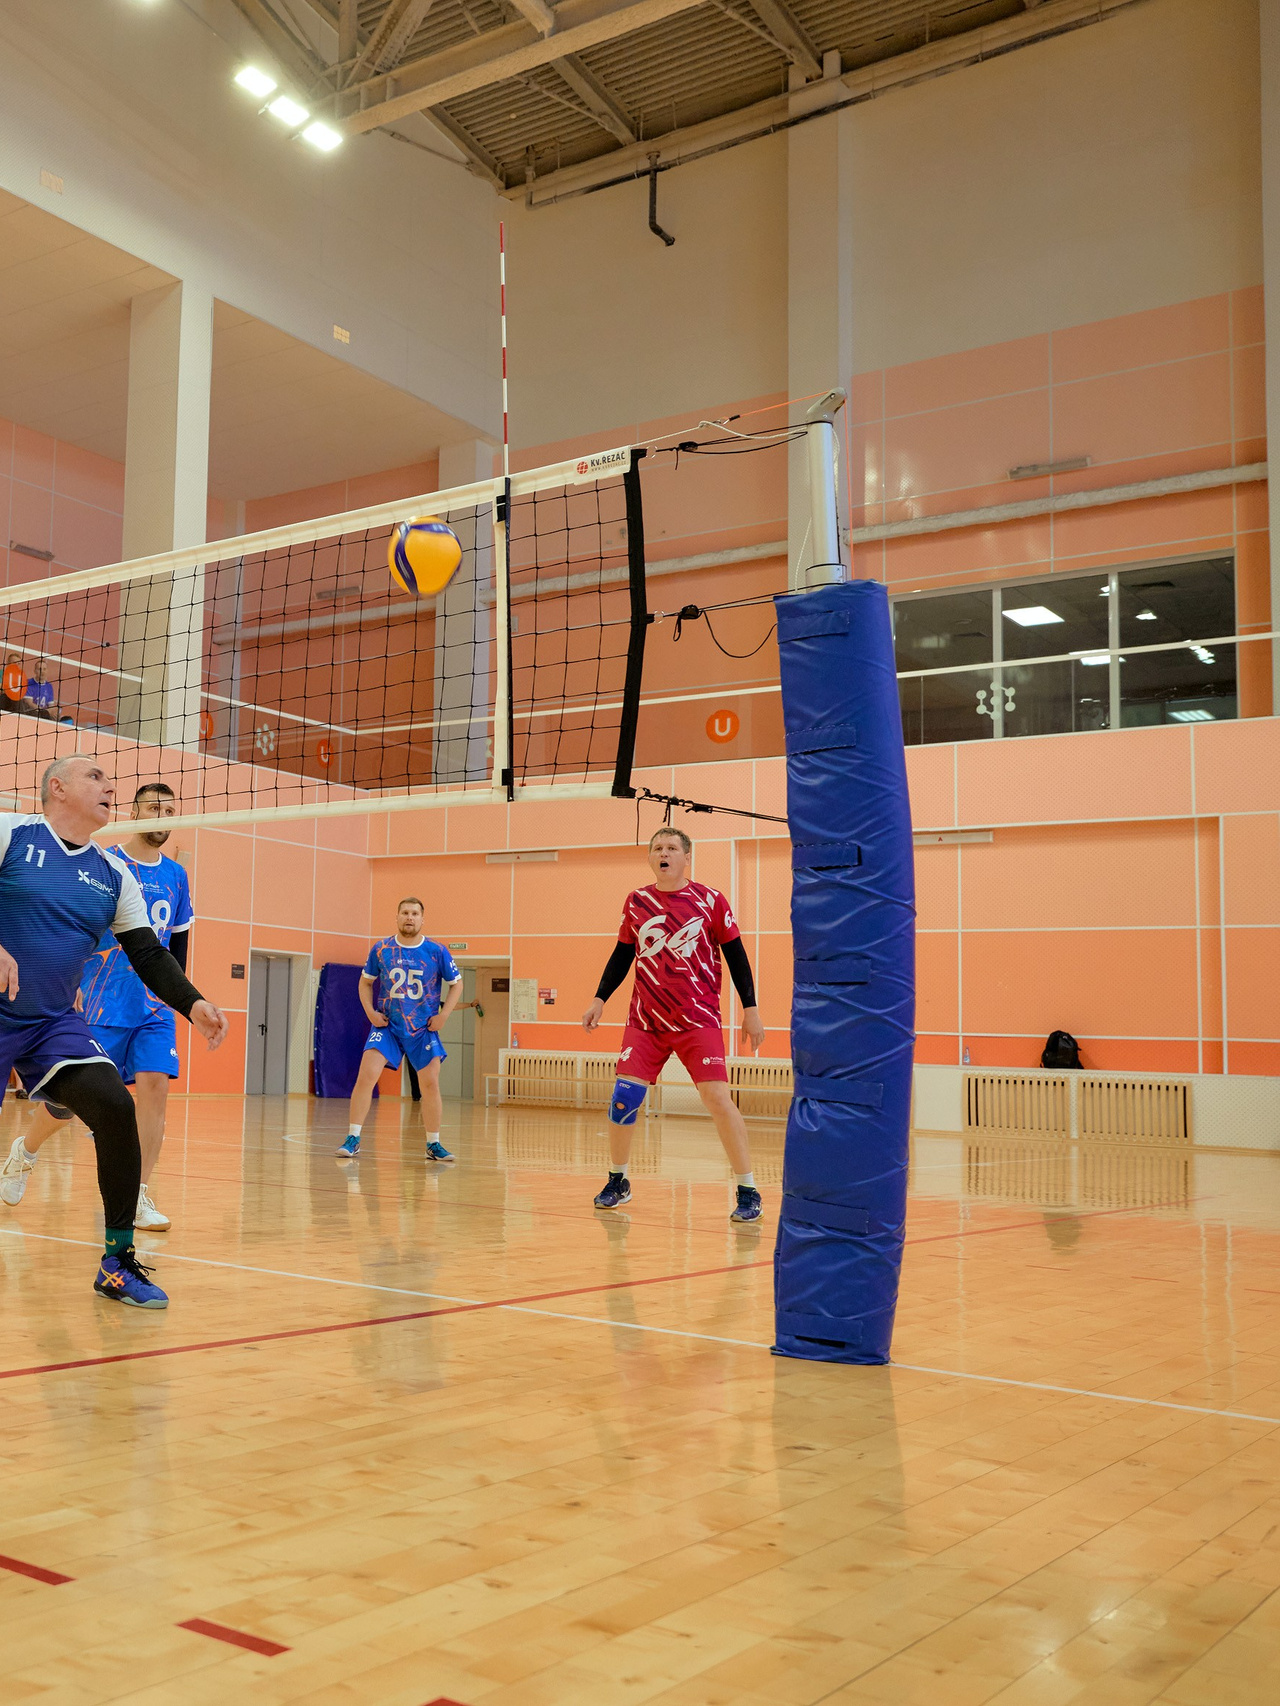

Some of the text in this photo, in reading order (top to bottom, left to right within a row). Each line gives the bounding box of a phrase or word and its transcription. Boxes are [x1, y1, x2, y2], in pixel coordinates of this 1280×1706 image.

[715, 717, 731, 736] U
[24, 843, 46, 868] 11
[638, 914, 705, 958] 64
[389, 967, 424, 1000] 25
[368, 1031, 383, 1043] 25
